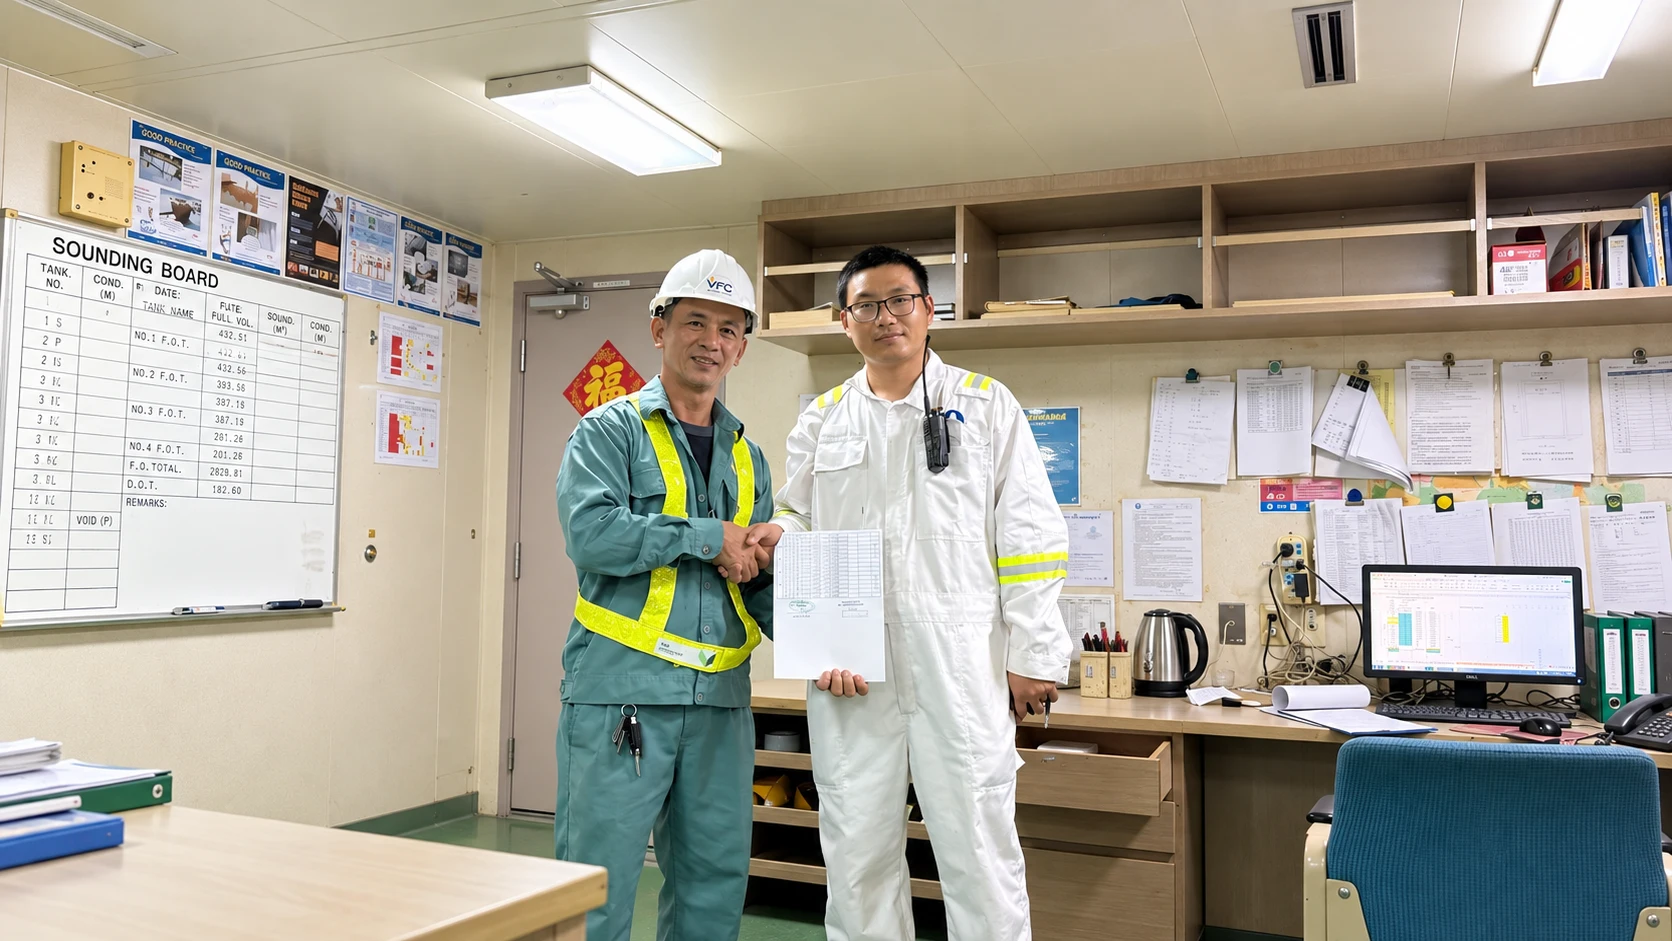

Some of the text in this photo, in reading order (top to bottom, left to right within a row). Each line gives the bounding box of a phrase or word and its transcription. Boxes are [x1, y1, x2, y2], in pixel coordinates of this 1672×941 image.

[141, 128, 163, 142] GOOD
[52, 236, 219, 289] SOUNDING BOARD
[40, 262, 71, 278] TANK.
[46, 277, 64, 290] NO.
[93, 274, 124, 289] COND.
[706, 278, 733, 293] VFC
[99, 289, 116, 301] (M)
[154, 285, 181, 299] DATE:
[170, 306, 195, 320] NAME
[267, 311, 295, 325] SOUND.
[236, 316, 254, 328] VOL.
[309, 321, 333, 334] COND.
[42, 335, 62, 347] 2 P
[134, 330, 190, 349] NO.1 F.O.T.
[132, 367, 188, 384] NO.2 F.O.T.
[583, 361, 627, 408] 福
[131, 404, 186, 419] NO.3 F.O.T.
[129, 441, 185, 456] NO.4 F.O.T.
[126, 479, 158, 490] D.O.T.
[125, 497, 168, 508] REMARKS:
[76, 515, 113, 527] VOID (P)
